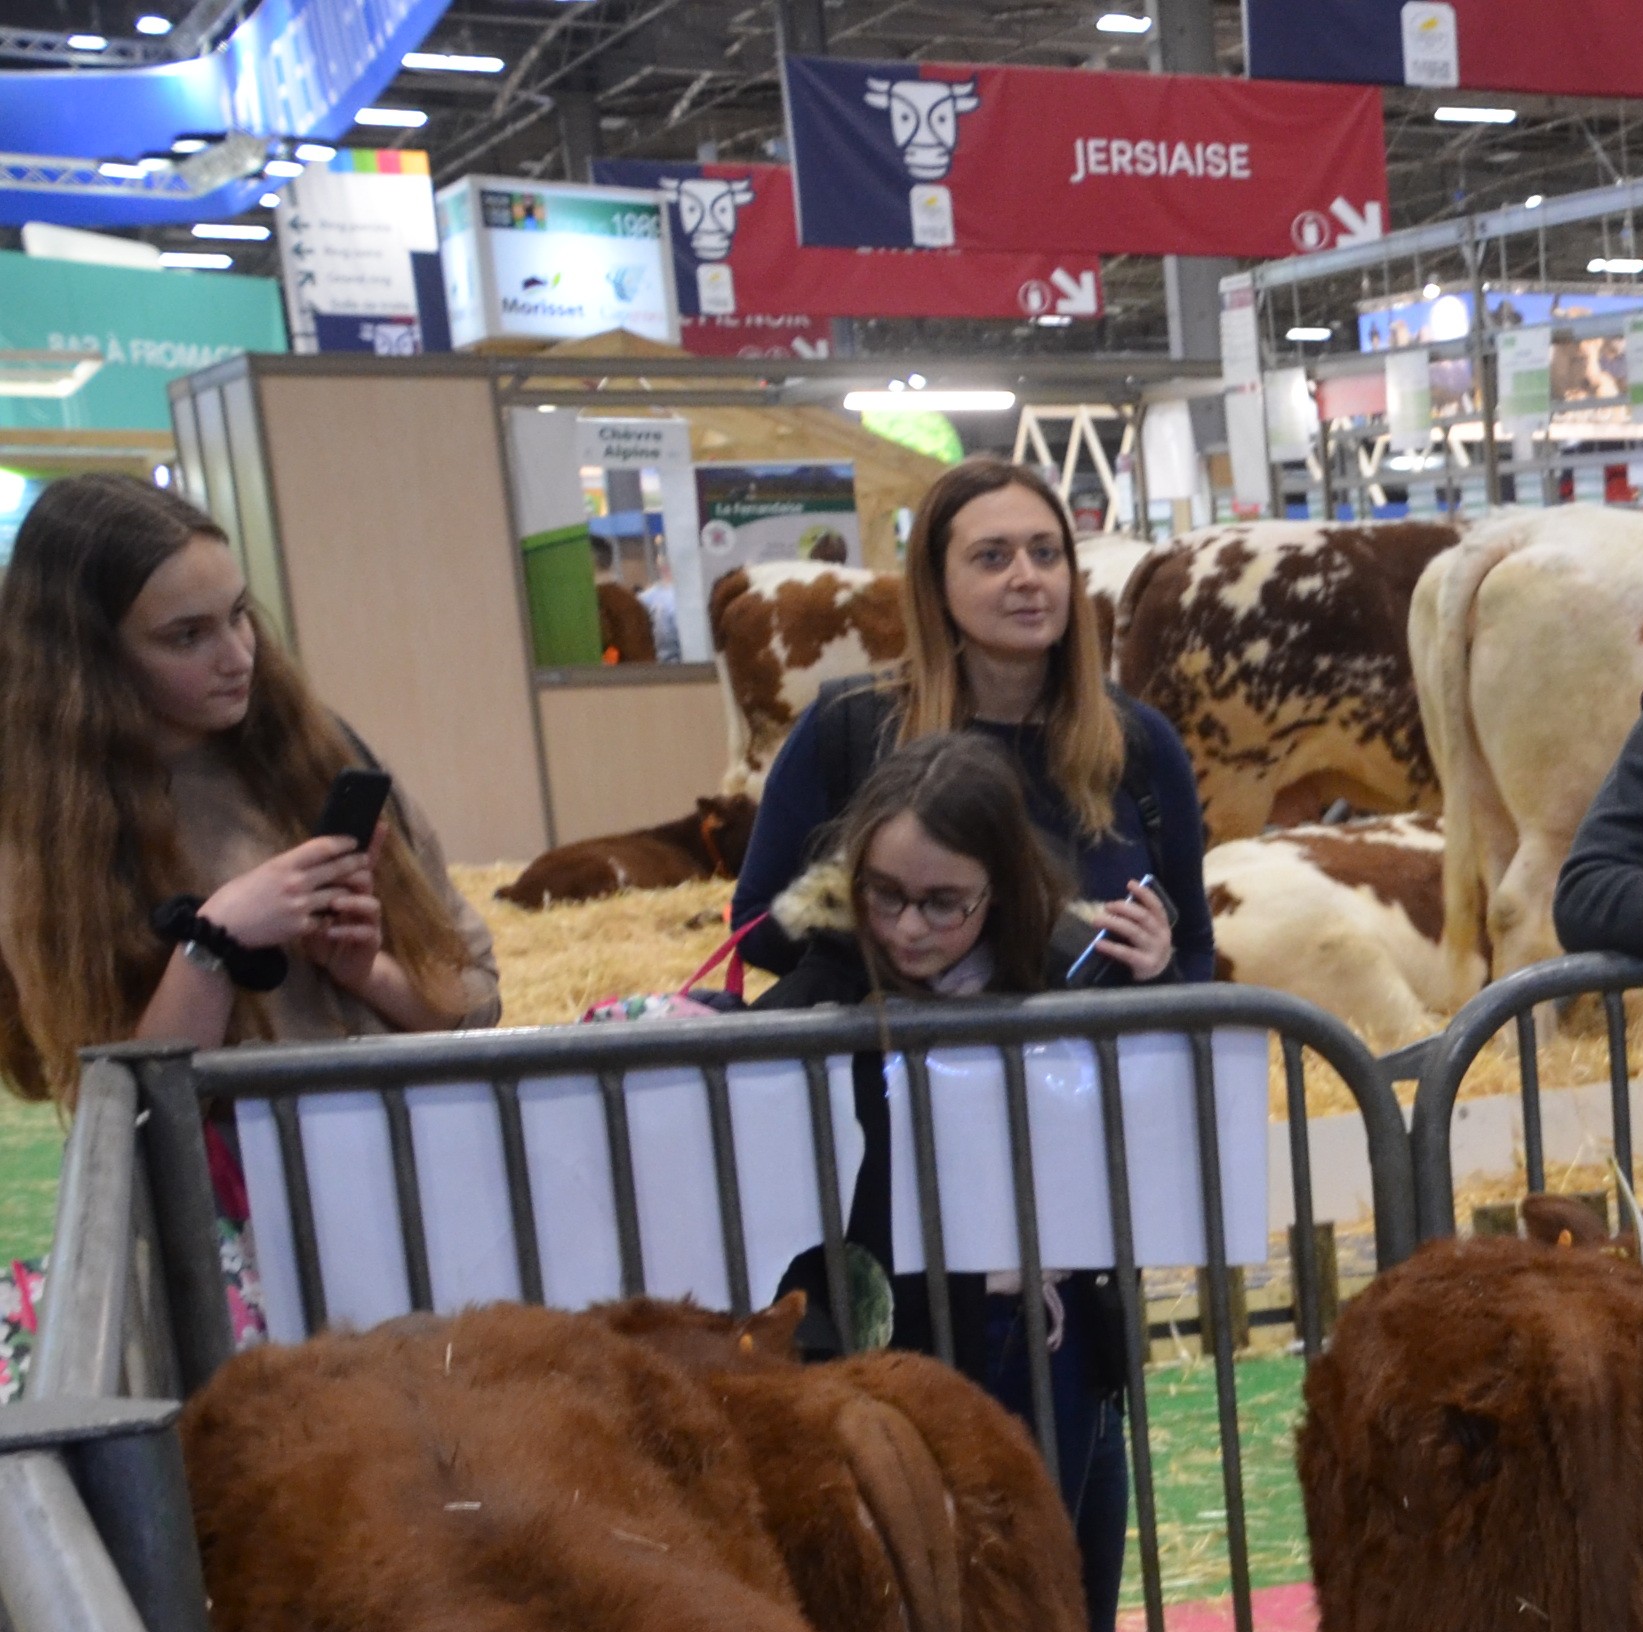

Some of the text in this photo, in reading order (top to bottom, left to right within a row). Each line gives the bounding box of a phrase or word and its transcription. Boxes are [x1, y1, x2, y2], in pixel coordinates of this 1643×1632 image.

[1069, 137, 1252, 184] JERSIAISE
[502, 297, 585, 318] Morisset
[129, 339, 246, 368] FROMA
[604, 443, 660, 460] Alpine
